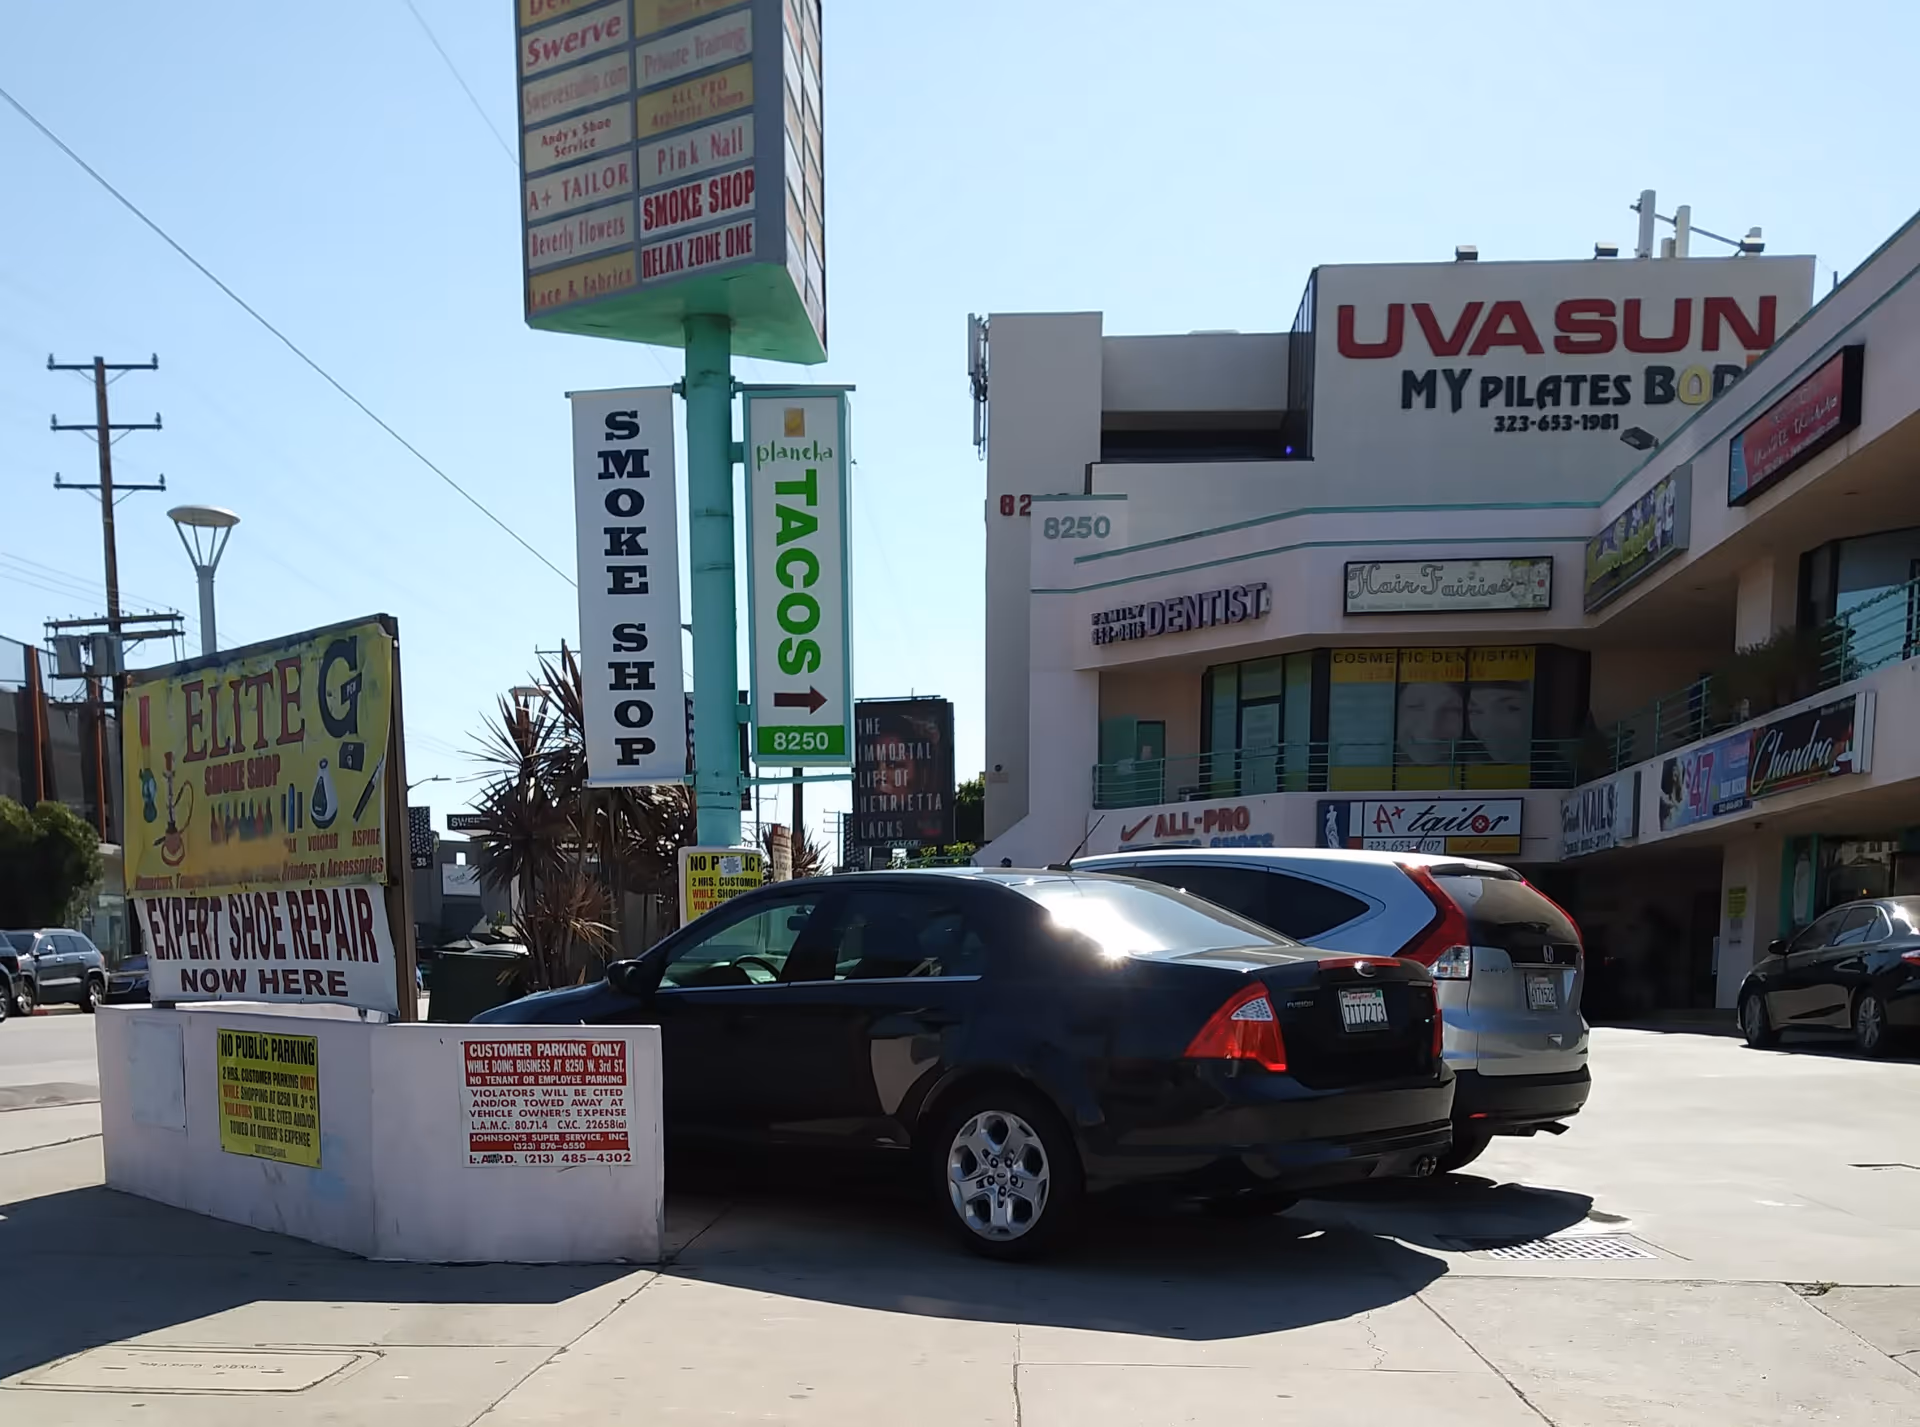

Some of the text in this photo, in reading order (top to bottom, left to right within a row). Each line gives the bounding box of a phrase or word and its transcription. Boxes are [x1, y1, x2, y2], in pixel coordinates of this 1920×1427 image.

[526, 15, 621, 67] Swerve
[541, 117, 611, 148] Andy's Shoe
[554, 136, 595, 158] Service
[658, 126, 743, 176] Pink Nail
[529, 163, 629, 211] A+ TAILOR
[643, 169, 755, 231] SMOKE SHOP
[532, 226, 574, 257] Beverly
[643, 223, 752, 279] RELAX ZONE ONE
[1401, 368, 1472, 413] MY
[1479, 373, 1632, 408] PILATES
[1644, 364, 1745, 404] BOD
[1494, 413, 1619, 433] 323-653-1981
[756, 442, 833, 471] plancha
[1044, 516, 1111, 539] 8250
[775, 469, 821, 675] TACOS
[1348, 563, 1513, 599] Hair Fairies
[598, 410, 656, 766] SMOKE SHOP
[1145, 582, 1268, 636] DENTIST
[1333, 652, 1428, 664] COSMETIC
[318, 635, 362, 738] G
[182, 657, 305, 763] ELITE
[858, 718, 880, 735] THE
[773, 732, 829, 750] 8250
[858, 742, 931, 762] IMMORTAL
[1750, 719, 1833, 795] Chandra
[205, 753, 281, 797] SMOKE SHOP
[860, 770, 908, 788] LIFE OF
[860, 794, 942, 813] HENRIETTA
[1582, 784, 1614, 834] NAILS
[861, 821, 903, 839] LACKS
[1154, 806, 1250, 837] ALL-PRO
[1408, 805, 1509, 843] tailor
[352, 828, 380, 847] ASPIRE
[328, 855, 384, 879] Accessories
[690, 855, 707, 871] NO
[692, 878, 697, 887] 2
[719, 877, 758, 887] CUSTOMER
[146, 888, 380, 963] EXPERT SHOE REPAIR
[180, 968, 349, 997] NOW HERE
[221, 1034, 315, 1066] NO PUBLIC PARKING
[470, 1043, 621, 1057] CUSTOMER PARKING ONLY
[223, 1066, 226, 1080] 2
[241, 1068, 272, 1086] CUSTOMER
[273, 1072, 299, 1089] PARKING
[467, 1060, 489, 1074] WHILE
[492, 1060, 514, 1073] DOING
[516, 1059, 550, 1073] BUSINESS
[554, 1059, 562, 1072] AT
[565, 1059, 584, 1072] 8250
[587, 1059, 597, 1073] W.
[599, 1059, 611, 1072] 3rd
[470, 1075, 623, 1085] NO TENANT OR EMPLOYEE PARKING
[241, 1086, 268, 1104] SHOPPING
[471, 1088, 623, 1098] VIOLATORS WILL BE CITED
[472, 1099, 624, 1108] AND/OR TOWED AWAY AT
[253, 1106, 267, 1121] WILL
[276, 1109, 292, 1125] CITED
[469, 1109, 627, 1118] VEHICLE OWNER'S EXPENSE
[230, 1120, 248, 1136] TOWED
[249, 1123, 257, 1137] AT
[284, 1129, 311, 1147] EXPENSE
[471, 1121, 510, 1131] L.A.M.C.
[557, 1120, 580, 1130] C.V.C.
[585, 1120, 627, 1130] 22658(a)
[471, 1133, 627, 1142] JOHNSON'S SUPER SERVICE, INC.
[513, 1142, 586, 1151] (323) 876-6550
[524, 1153, 554, 1164] (213)
[561, 1153, 632, 1163] 485-4302
